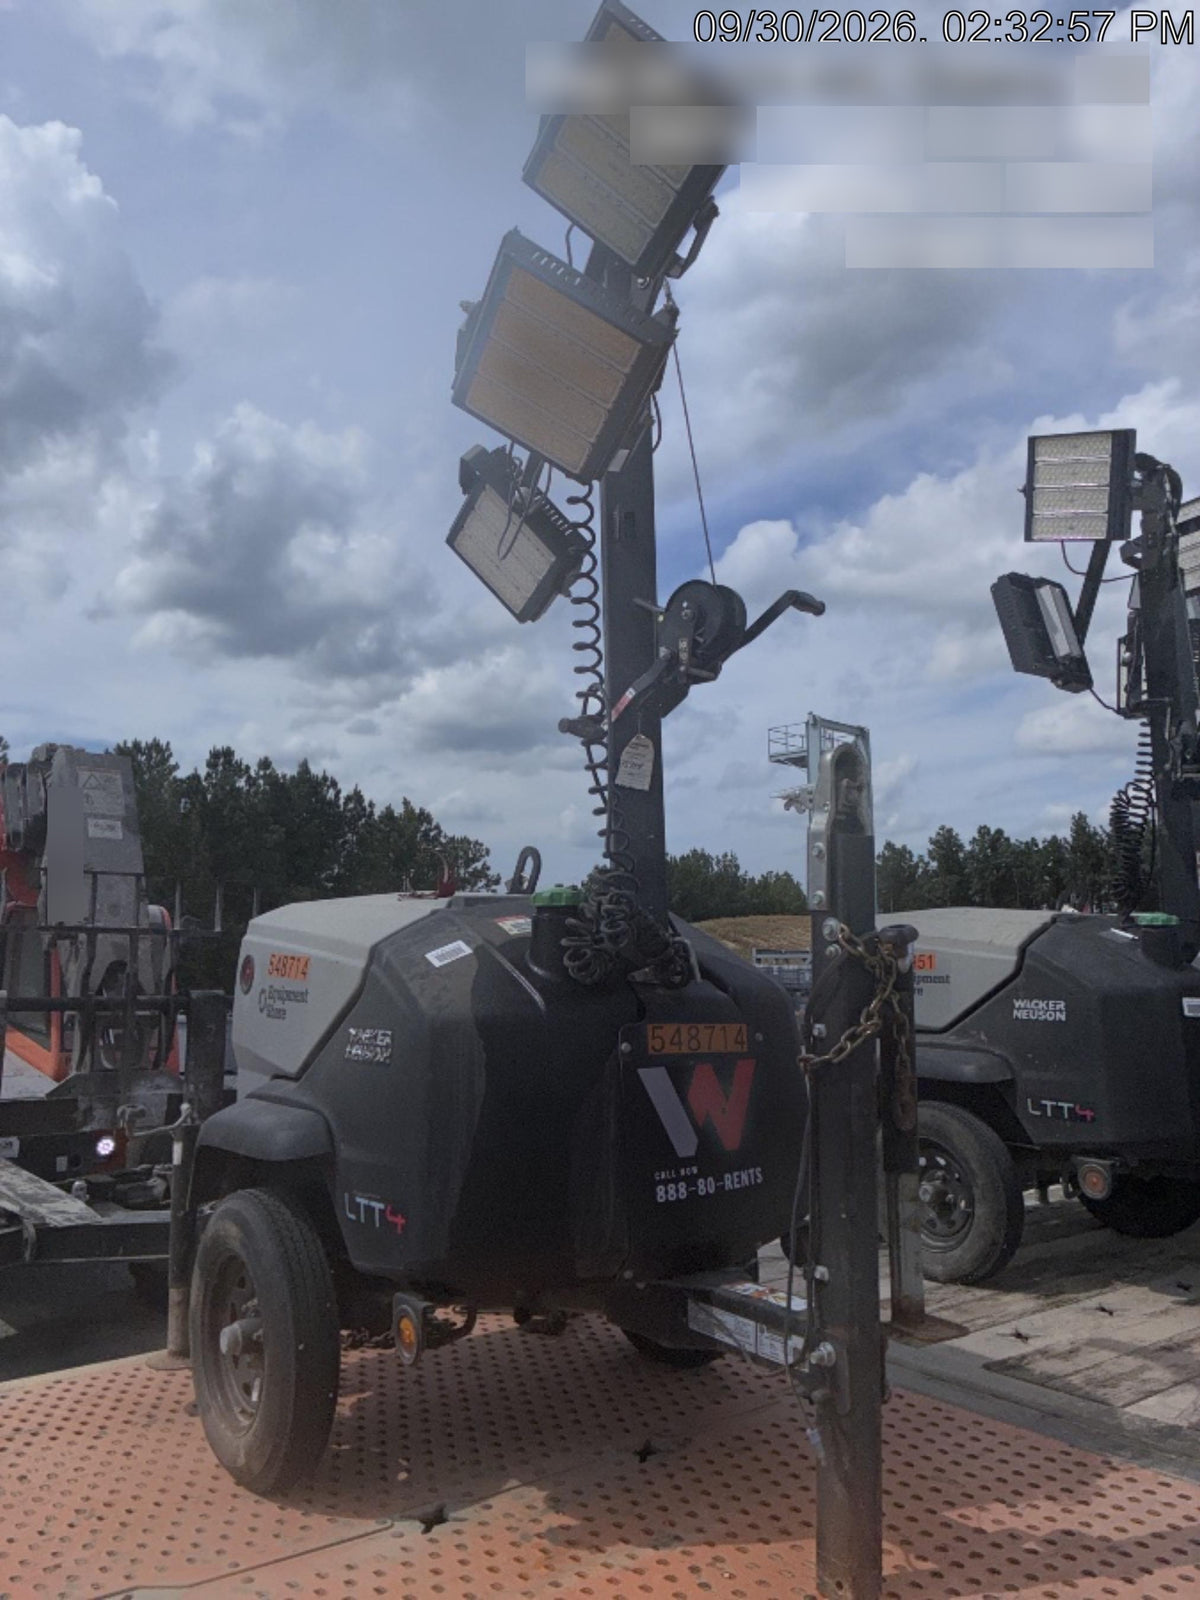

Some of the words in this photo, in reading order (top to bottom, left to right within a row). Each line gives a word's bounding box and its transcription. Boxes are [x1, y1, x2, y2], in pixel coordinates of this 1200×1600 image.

[267, 954, 310, 979] 548714
[1012, 998, 1066, 1011] WACKER
[1012, 1009, 1066, 1022] NEUSON
[651, 1024, 746, 1053] 548714
[1026, 1098, 1095, 1123] LTT4
[654, 1168, 677, 1180] CALL
[655, 1167, 763, 1203] 888-80-RENTS
[343, 1191, 407, 1236] LTT4
